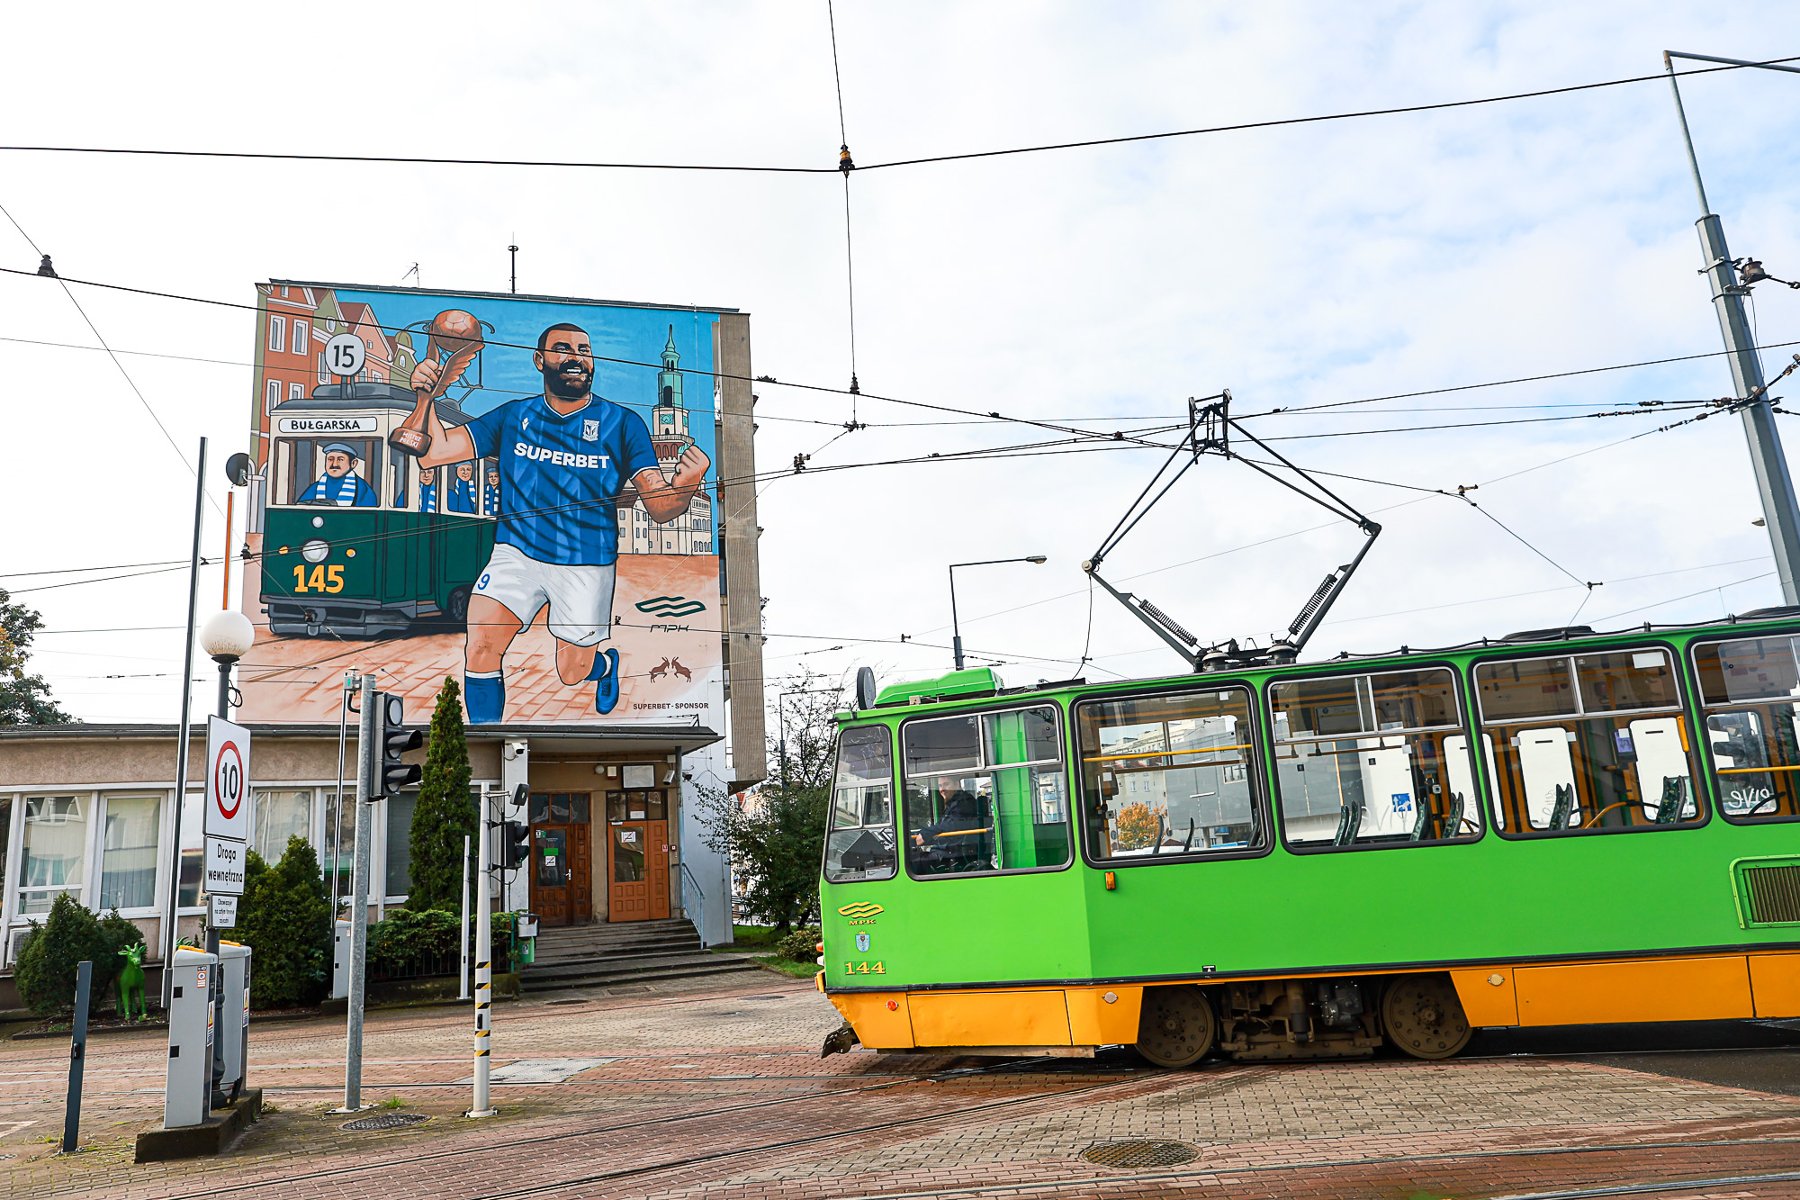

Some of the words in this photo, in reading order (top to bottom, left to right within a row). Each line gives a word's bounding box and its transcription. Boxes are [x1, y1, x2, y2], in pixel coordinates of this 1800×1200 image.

[333, 345, 355, 368] 15
[291, 420, 360, 430] BUŁGARSKA
[514, 442, 610, 469] SUPERBET
[293, 564, 345, 594] 145
[477, 573, 490, 590] 9
[222, 762, 238, 800] 10
[217, 844, 237, 863] Droga
[208, 869, 242, 885] wewnętrzna
[844, 961, 886, 975] 144
